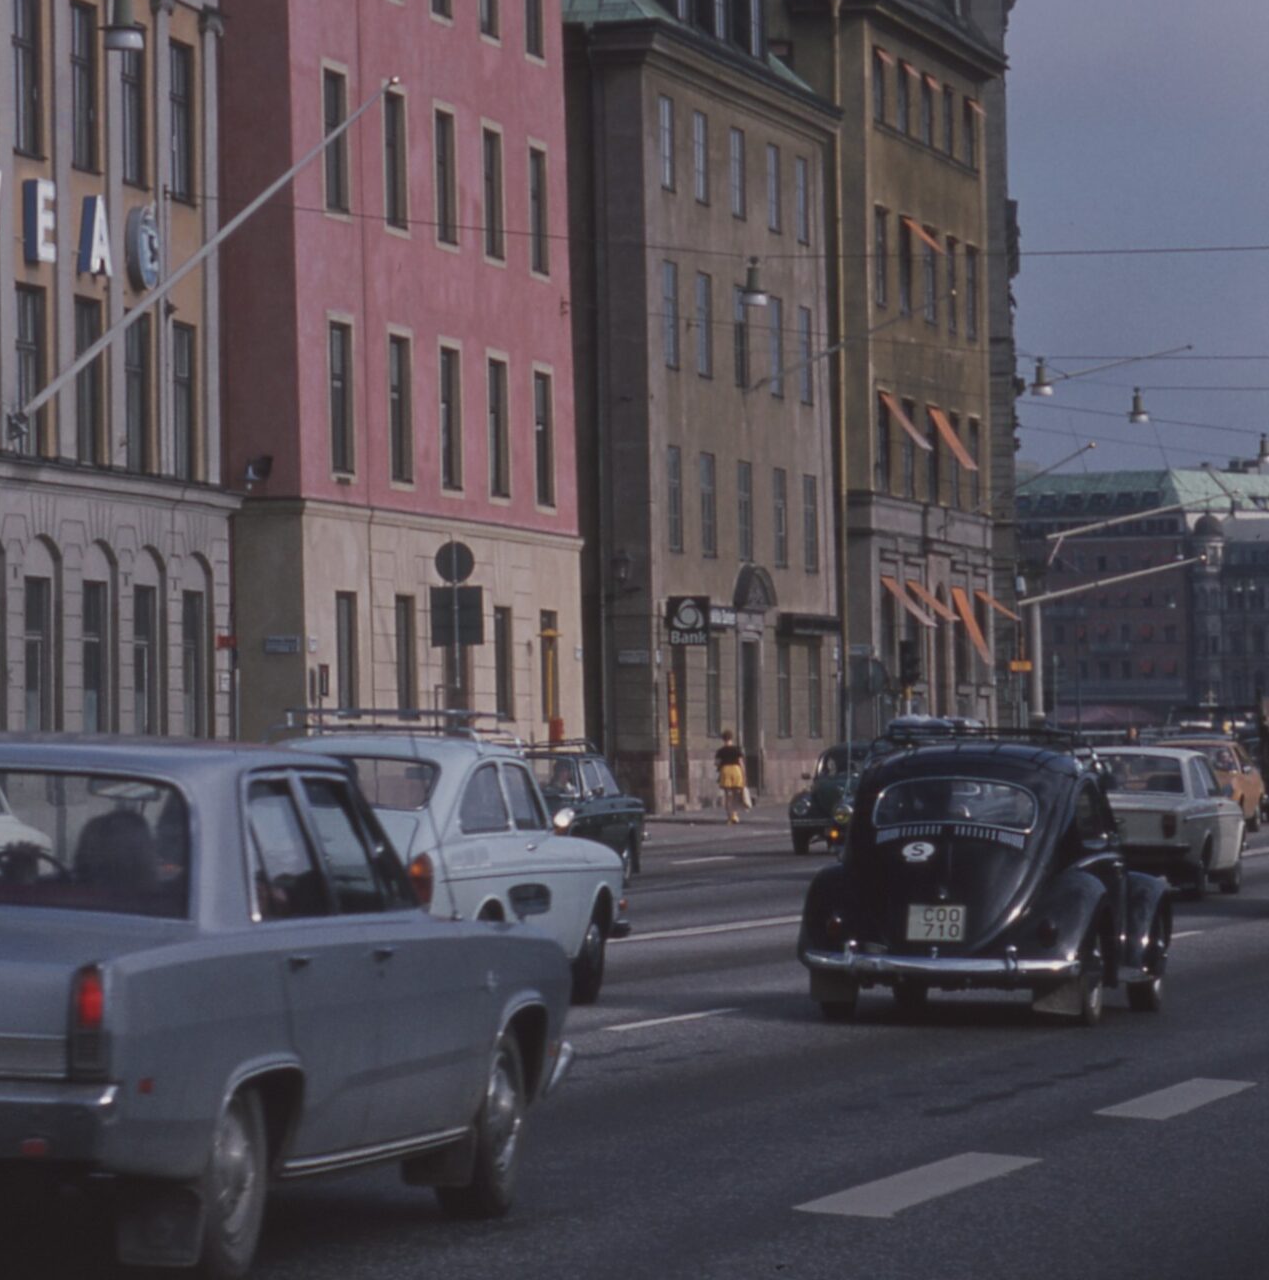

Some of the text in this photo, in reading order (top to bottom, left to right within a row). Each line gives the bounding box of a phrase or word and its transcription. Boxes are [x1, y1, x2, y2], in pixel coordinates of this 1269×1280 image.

[670, 630, 708, 646] Bank
[911, 843, 925, 857] S
[923, 923, 960, 938] 710
